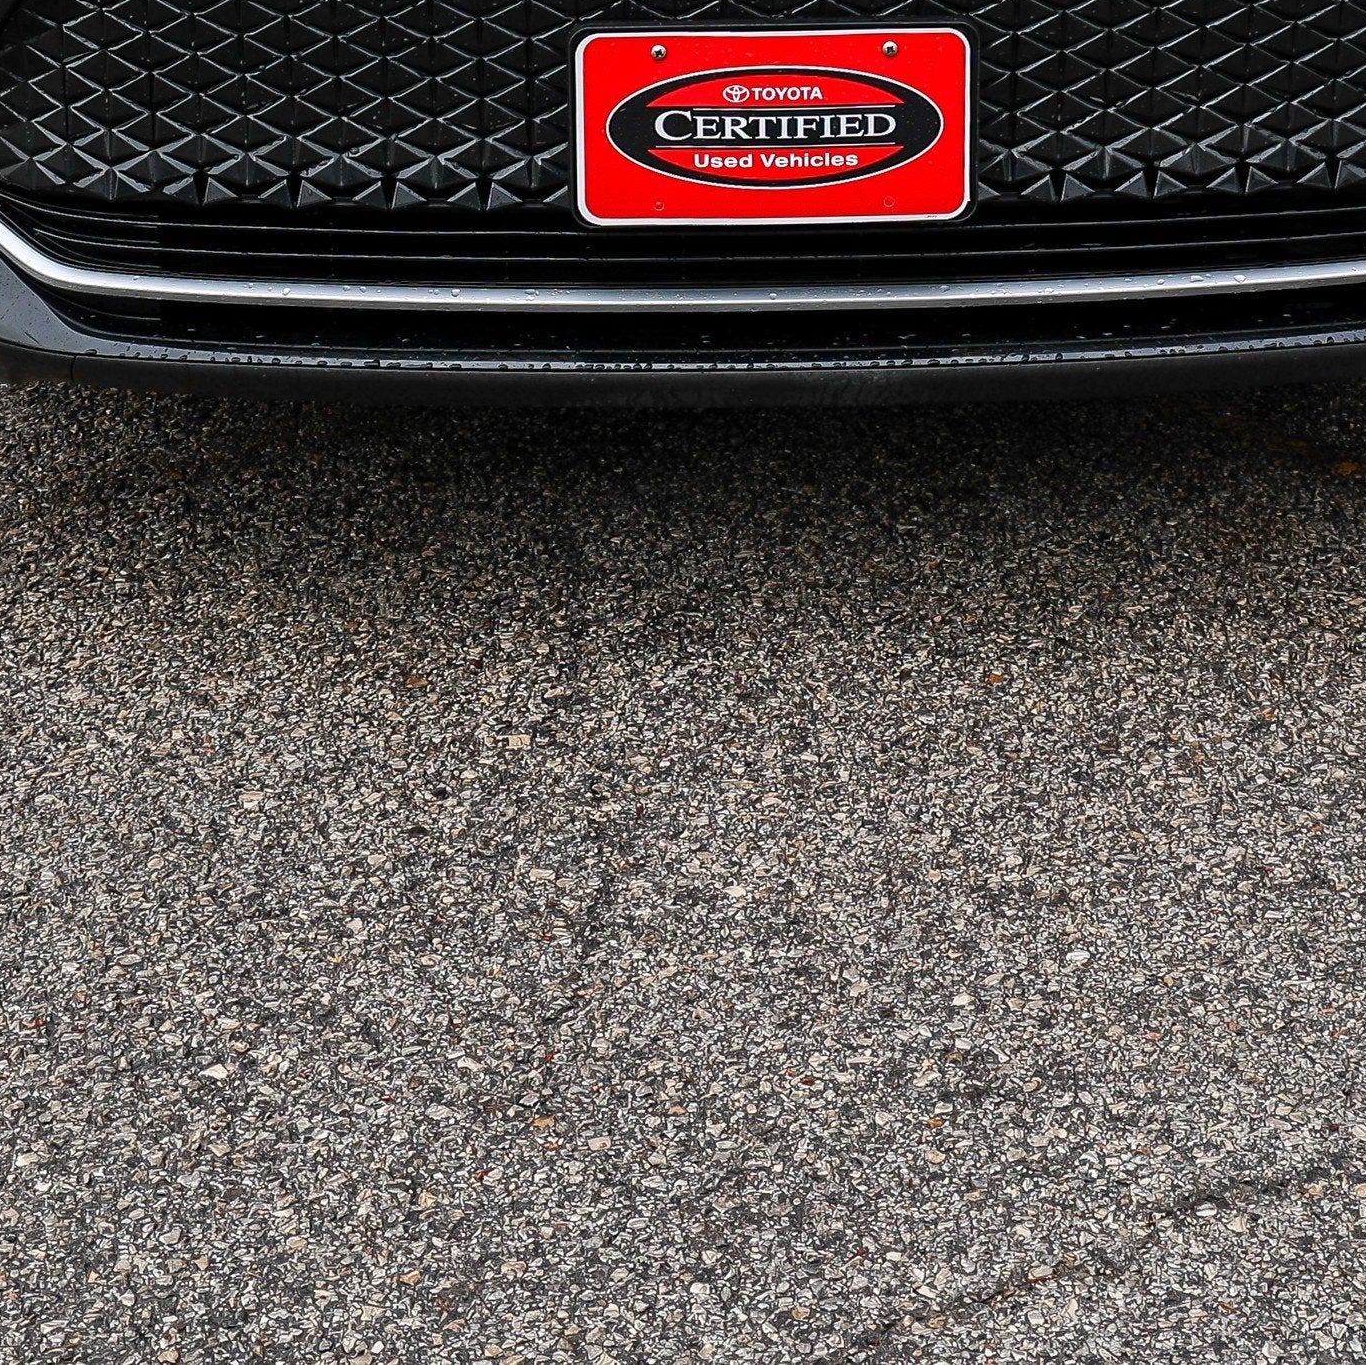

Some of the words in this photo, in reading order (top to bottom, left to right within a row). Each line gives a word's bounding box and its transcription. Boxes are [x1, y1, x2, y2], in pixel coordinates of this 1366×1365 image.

[751, 86, 823, 101] TOYOTA
[654, 110, 897, 141] CERTIFIED
[694, 153, 753, 169] Used
[760, 152, 859, 168] Vehicles
